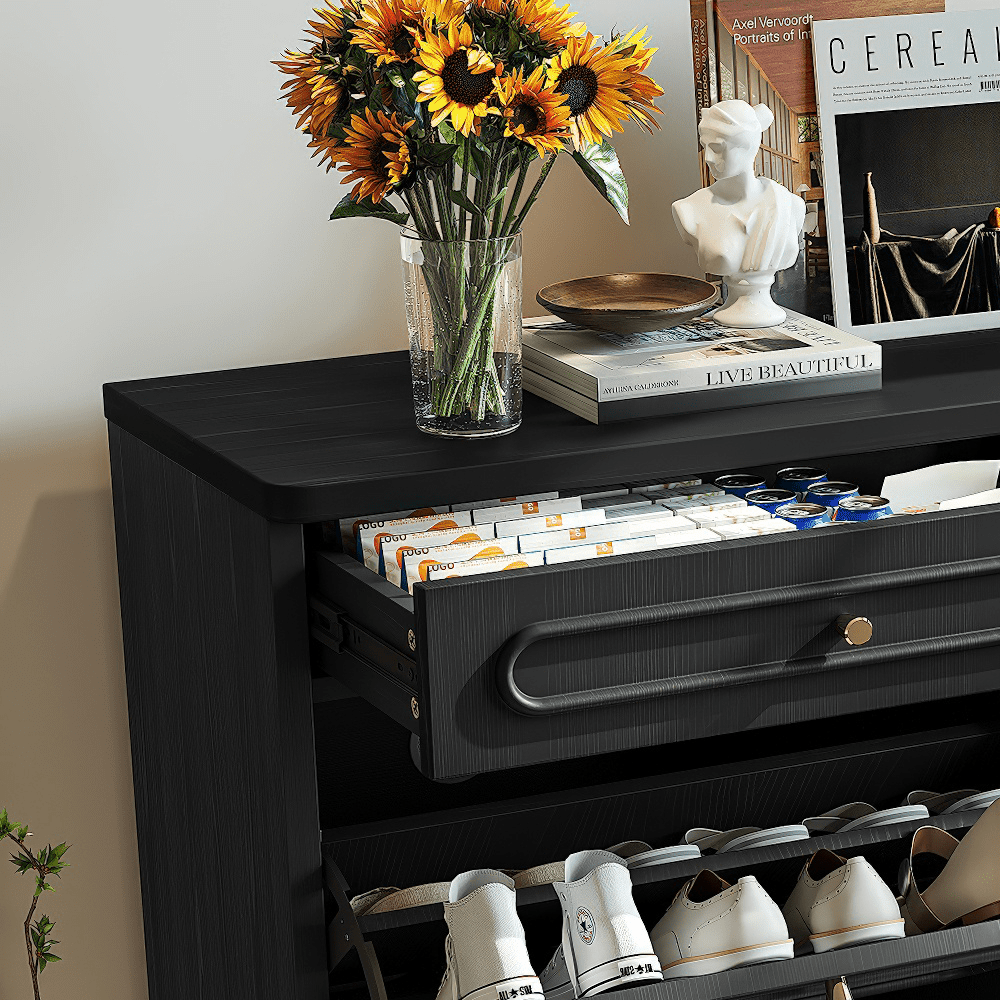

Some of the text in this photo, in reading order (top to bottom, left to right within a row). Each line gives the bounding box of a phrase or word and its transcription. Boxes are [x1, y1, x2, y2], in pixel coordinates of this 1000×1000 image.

[732, 17, 757, 30] Axel
[733, 31, 780, 45] Portraits
[783, 29, 795, 42] of
[706, 354, 873, 386] LIVE BEAUTIFUL
[380, 533, 407, 544] LOGO
